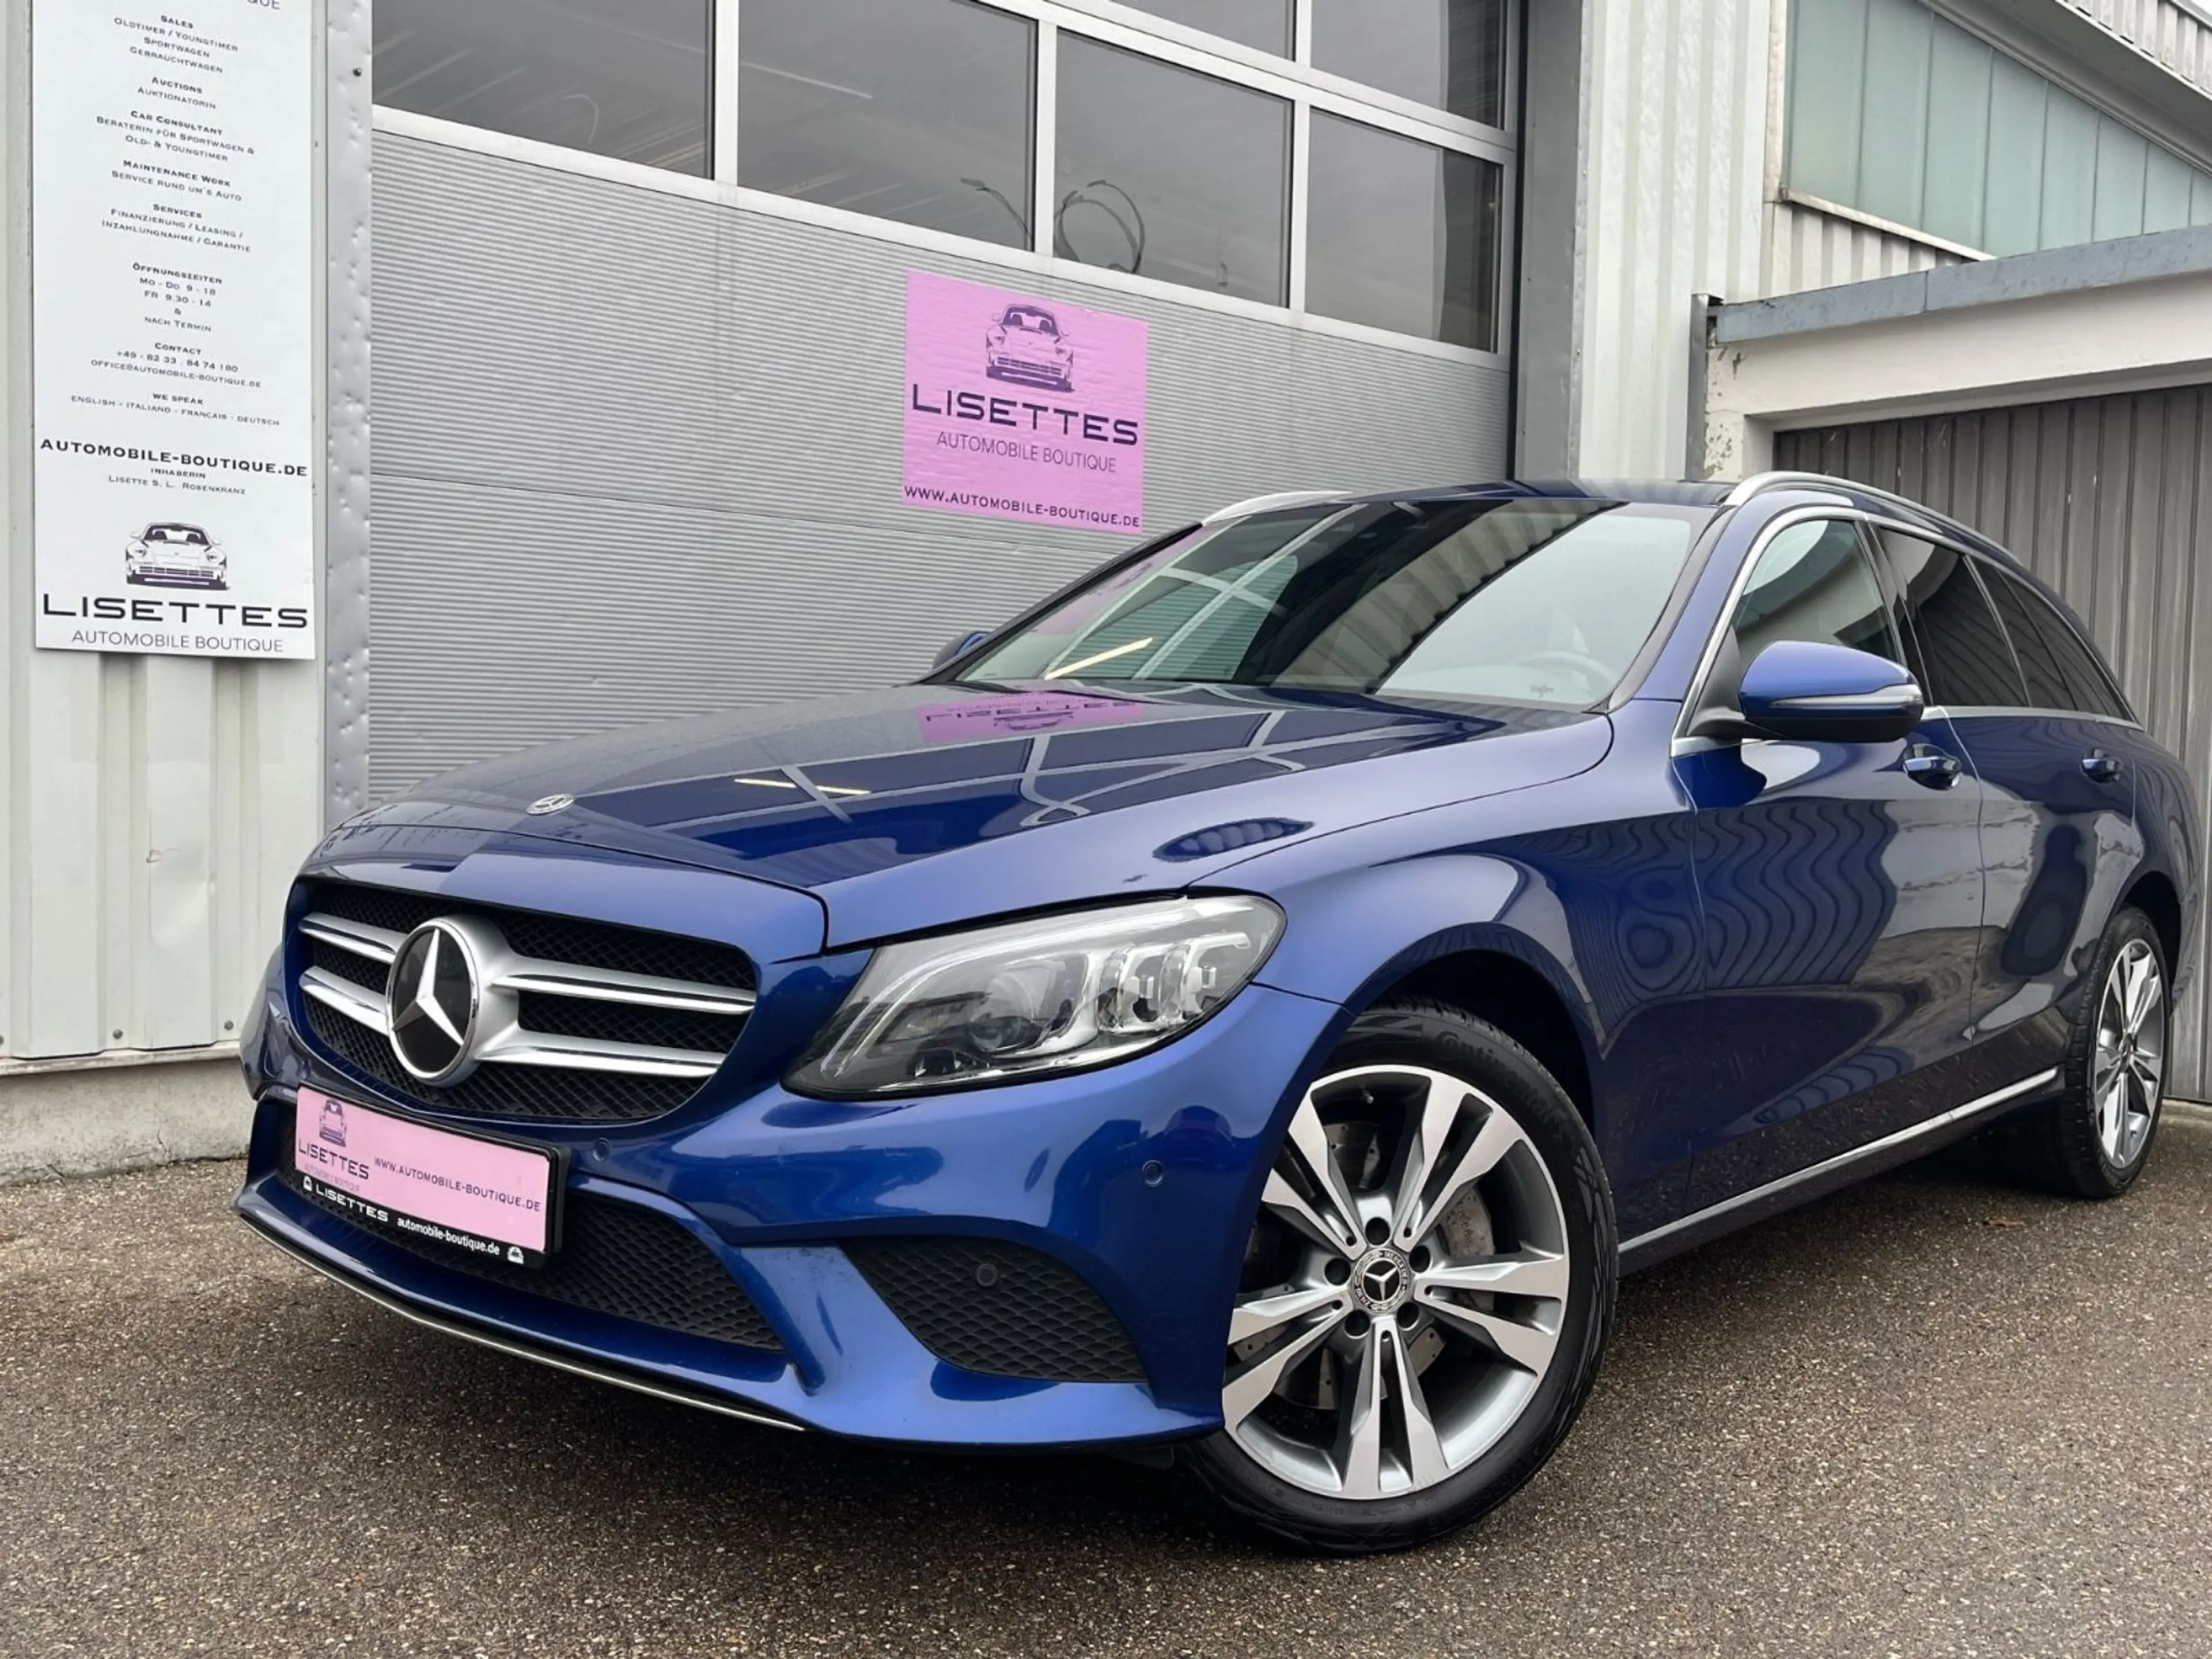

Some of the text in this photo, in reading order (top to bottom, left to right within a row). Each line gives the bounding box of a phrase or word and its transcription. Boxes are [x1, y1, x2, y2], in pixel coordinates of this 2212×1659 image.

[161, 15, 194, 29] SALES
[114, 17, 165, 35] OLDTIMER
[175, 31, 238, 52] YOUNGTIMER
[143, 37, 210, 58] SPORTWAGEN
[130, 46, 223, 74] GEBRAUCHTWAGEN
[138, 86, 217, 109] AUKTIONATORIN
[152, 77, 203, 94] AUCTIONS
[97, 116, 153, 134] BERATERIN
[180, 132, 244, 153] SPORTWAGEN
[130, 111, 223, 135] CAR CONSULTANT
[165, 143, 228, 162] YOUNGTIMER
[123, 160, 232, 187] MAINTENANCE WORK
[112, 171, 154, 185] SERVICE
[157, 180, 185, 190] RUND
[215, 190, 242, 202] AUTO
[111, 209, 185, 228] FINANZIERUNG
[195, 224, 236, 237] LEASING
[153, 204, 203, 218] SERVICES
[102, 220, 194, 243] INZAHLUNGNAHME
[203, 238, 251, 252] GARANTIE
[132, 262, 222, 285] ÖFFNUNGSZEITEN
[139, 277, 156, 286] MO
[166, 281, 180, 290] DO
[204, 288, 216, 296] 18
[144, 290, 158, 299] FR
[144, 316, 211, 333] NACH TERMIN
[116, 350, 137, 359] +49
[203, 362, 215, 370] 74
[154, 342, 202, 355] CONTACT
[71, 395, 116, 407] ENGLISH
[126, 402, 171, 414] ITALIANO
[237, 416, 280, 426] DEUTSCH
[153, 393, 204, 405] WE SPEAK
[912, 383, 1139, 446] LISETTES
[40, 439, 308, 477] AUTOMOBILE-BOUTIQUE.DE
[937, 431, 1116, 473] AUTOMOBILE BOUTIQUE
[108, 475, 149, 486] LISETTE
[182, 482, 247, 495] ROSENKRANZ
[150, 468, 205, 479] INHABERIN
[904, 486, 1140, 528] WWW.AUTOMOBILE-BOUTIQUE.DE
[43, 593, 308, 629] LISETTES
[71, 630, 284, 653] AUTOMOBILE BOUTIQUE
[298, 1141, 370, 1181] LISETTES
[374, 1156, 541, 1212] WWW.AUTOMOBILE-BOUTIQUE.DE
[316, 1183, 501, 1256] LISETTES automobile-boutique.de
